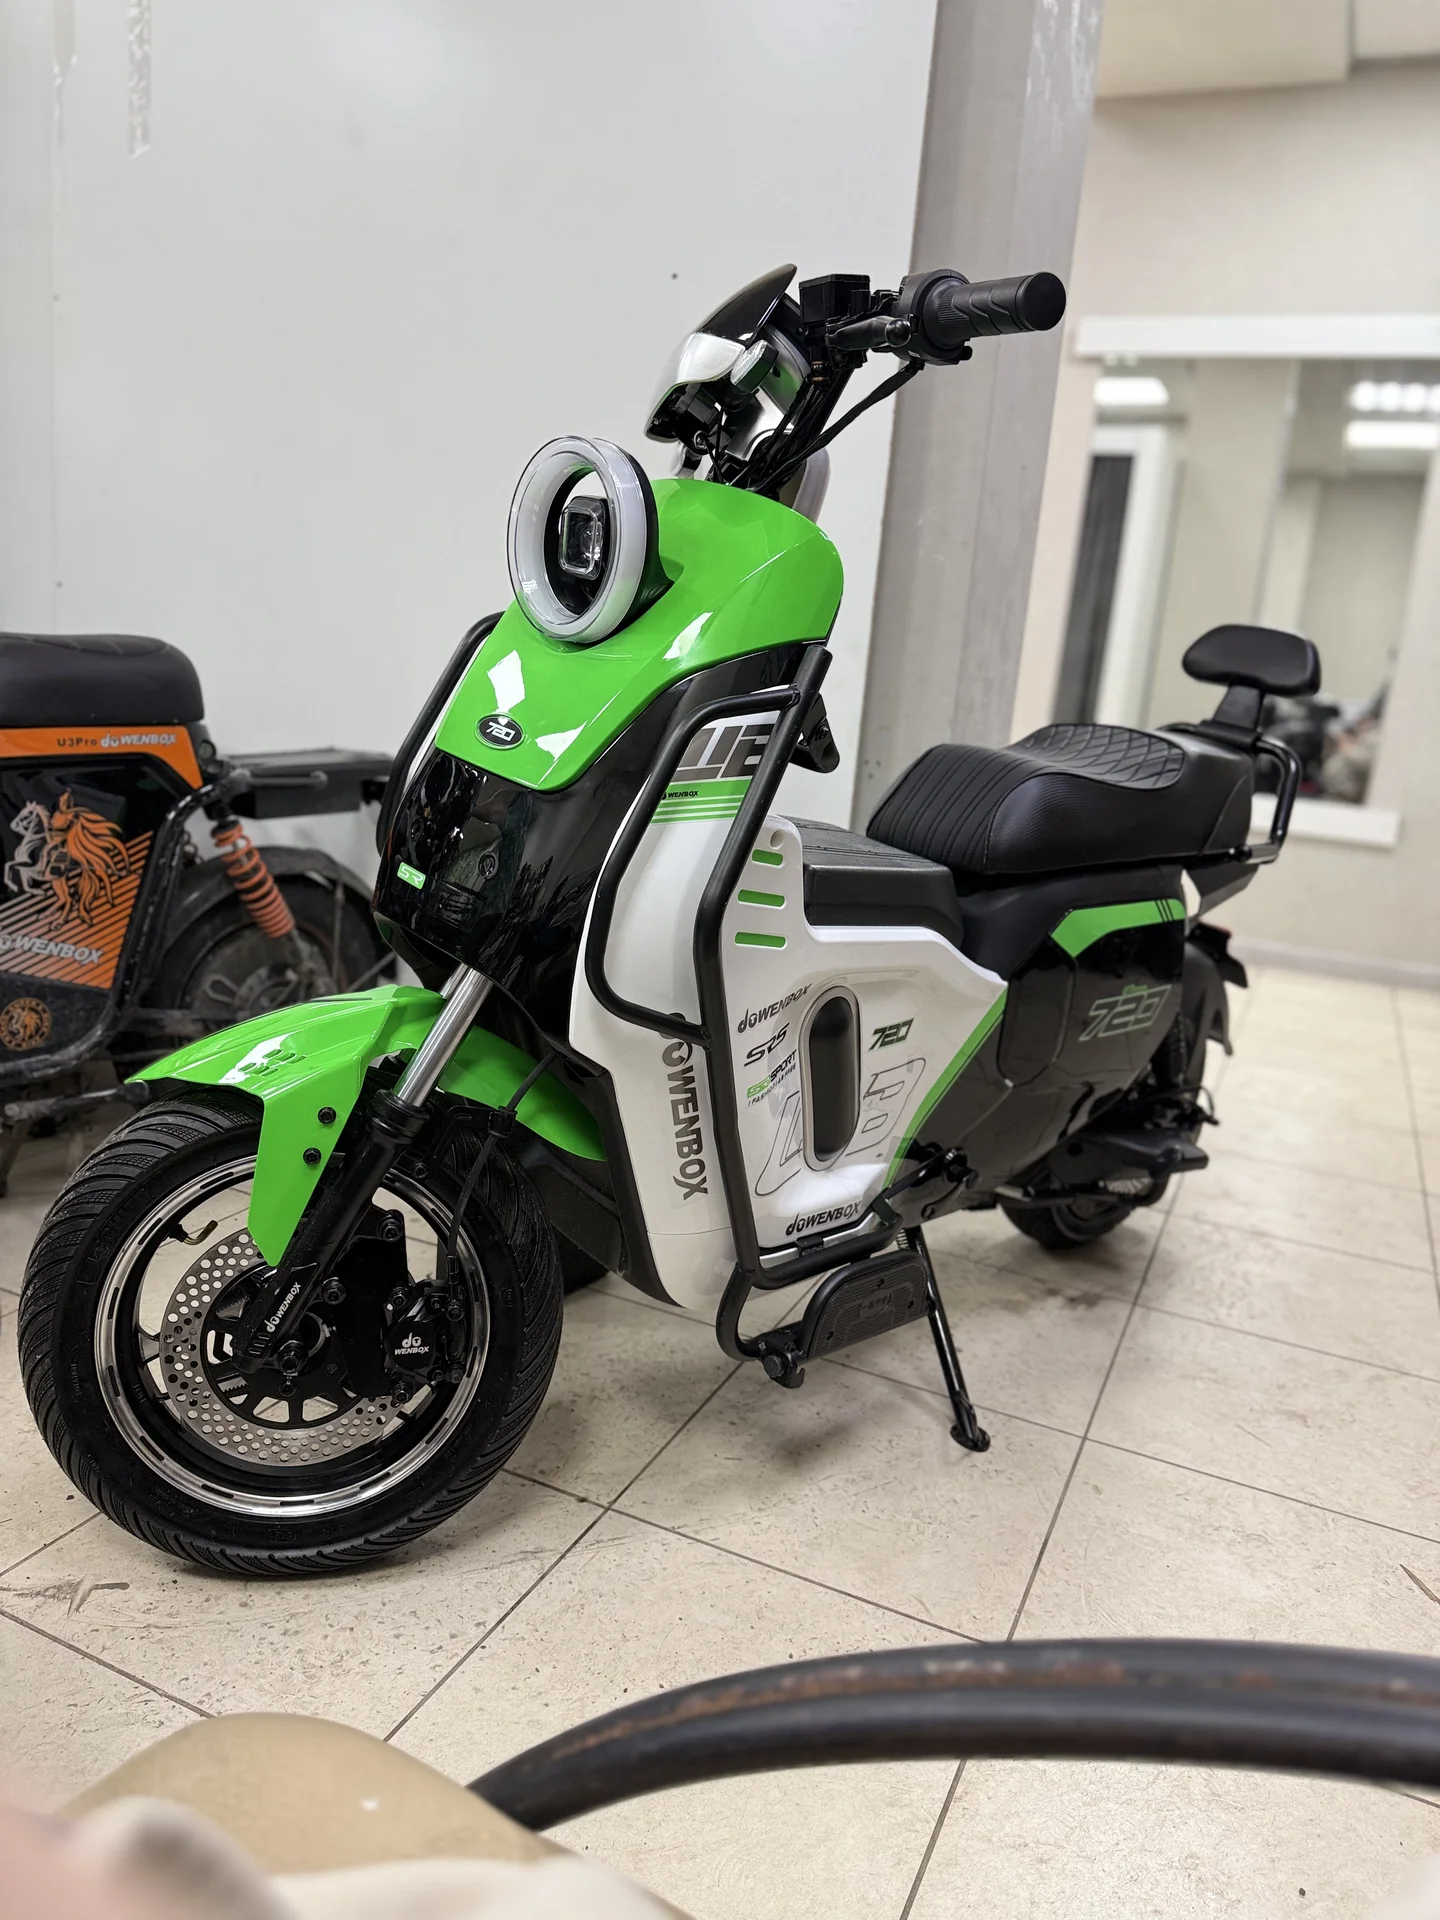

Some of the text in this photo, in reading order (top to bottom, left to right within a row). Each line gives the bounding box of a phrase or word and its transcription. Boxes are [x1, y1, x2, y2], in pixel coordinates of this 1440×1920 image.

[56, 737, 98, 748] U3Pro
[398, 865, 425, 887] SR
[868, 1017, 915, 1052] 720
[770, 1049, 798, 1082] SPORT
[394, 1345, 430, 1355] WENBOX
